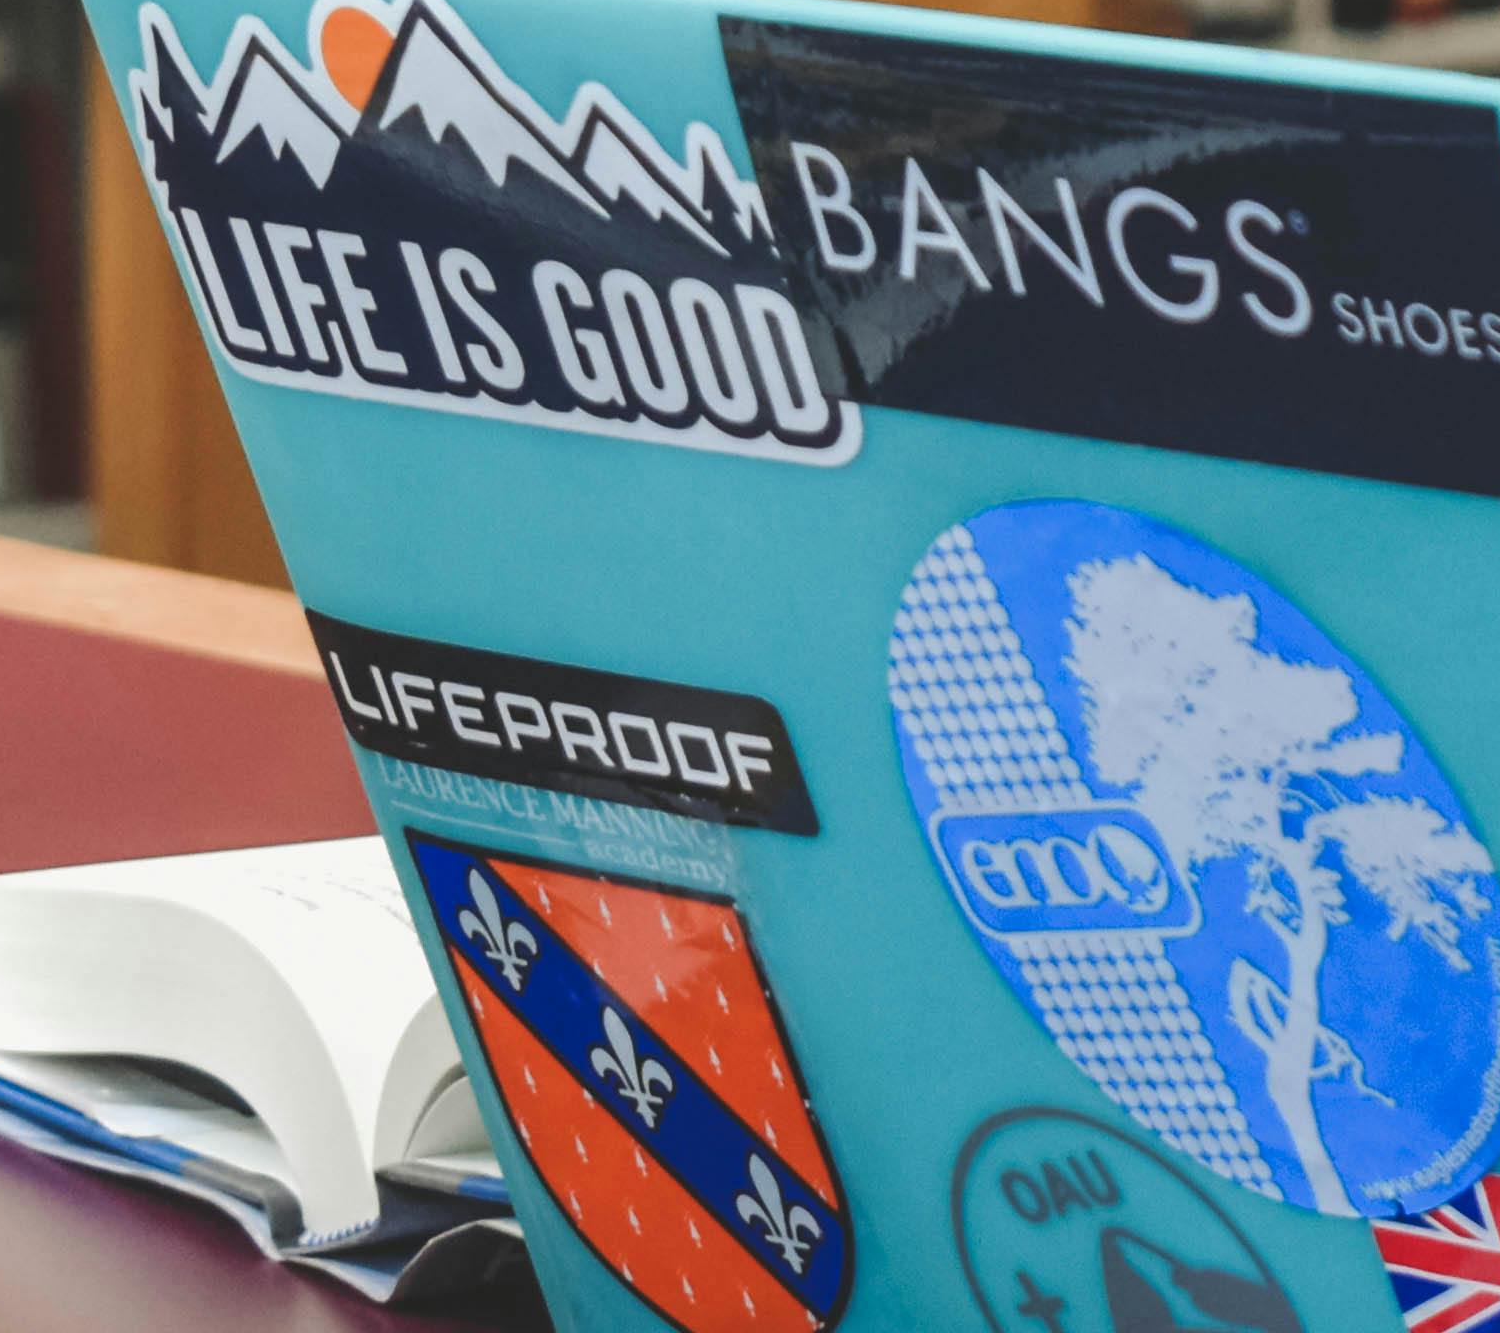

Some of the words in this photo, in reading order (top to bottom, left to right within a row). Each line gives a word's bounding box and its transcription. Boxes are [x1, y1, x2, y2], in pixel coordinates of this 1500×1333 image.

[790, 141, 1312, 337] BANGS
[182, 208, 405, 379] LIFE
[400, 239, 526, 392] IS
[531, 258, 831, 436] GOOD
[329, 650, 772, 793] LIFEPROOF
[375, 752, 547, 822] LAURENCE
[587, 838, 730, 891] academy
[1000, 1148, 1123, 1225] OAU
